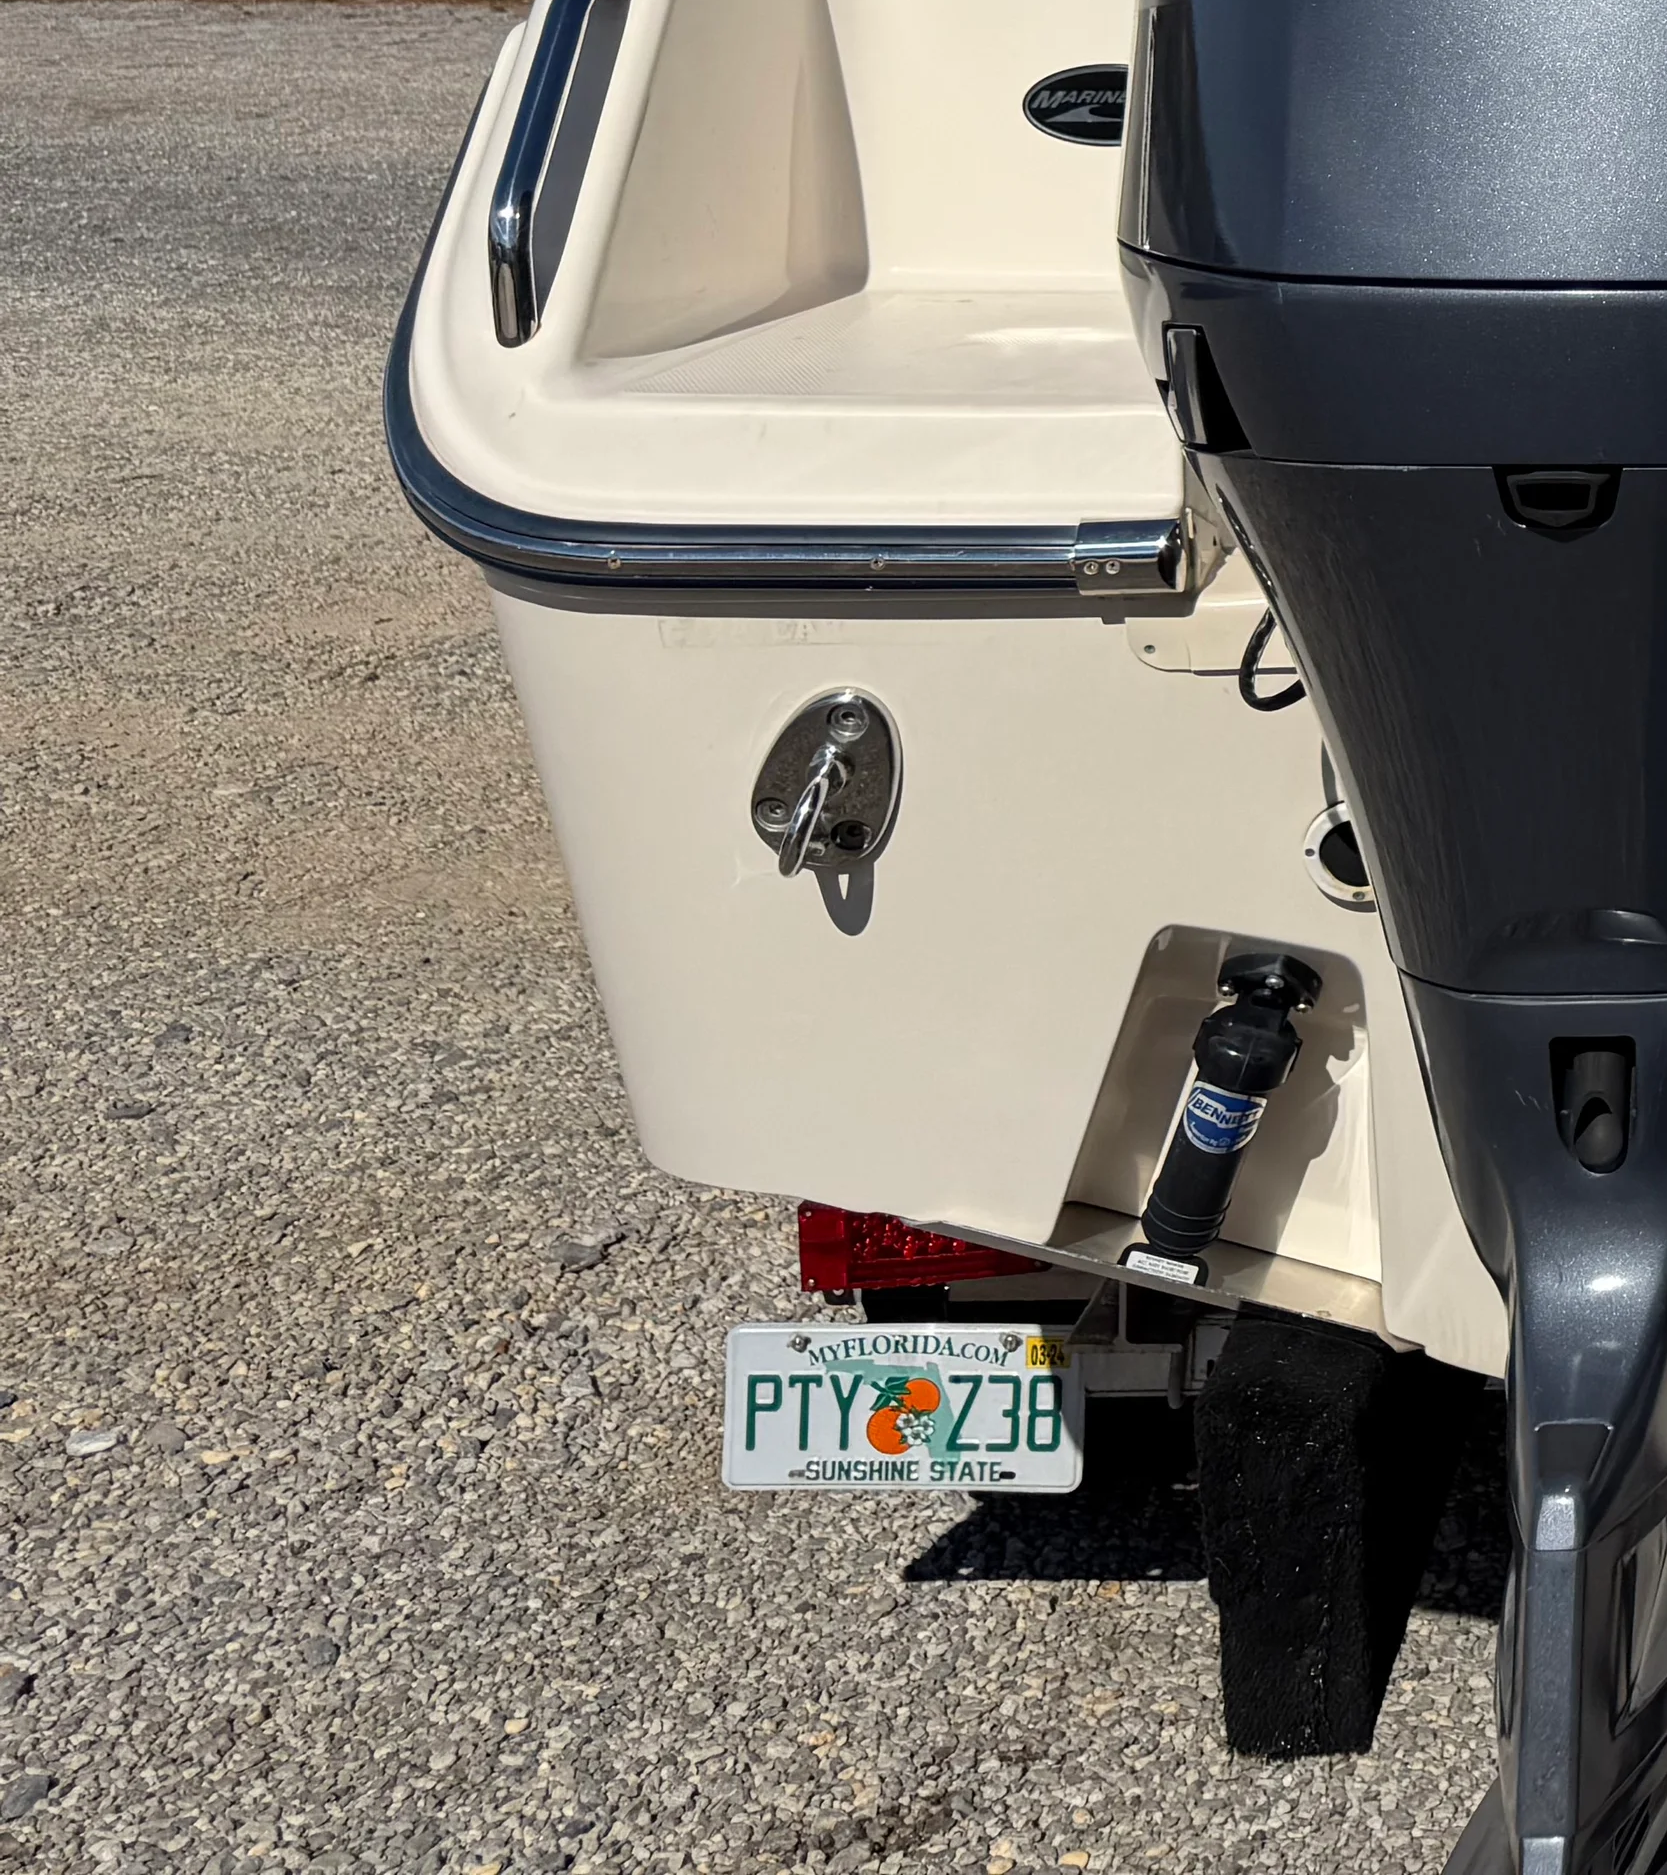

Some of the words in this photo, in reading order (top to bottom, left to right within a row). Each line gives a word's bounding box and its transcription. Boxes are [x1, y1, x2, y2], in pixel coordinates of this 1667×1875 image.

[807, 1334, 1009, 1367] MYFLORIDA.COM
[745, 1374, 864, 1451] PTY
[946, 1374, 1063, 1452] Z38
[805, 1460, 920, 1482] SUNSHINE
[929, 1461, 1002, 1483] STATE
